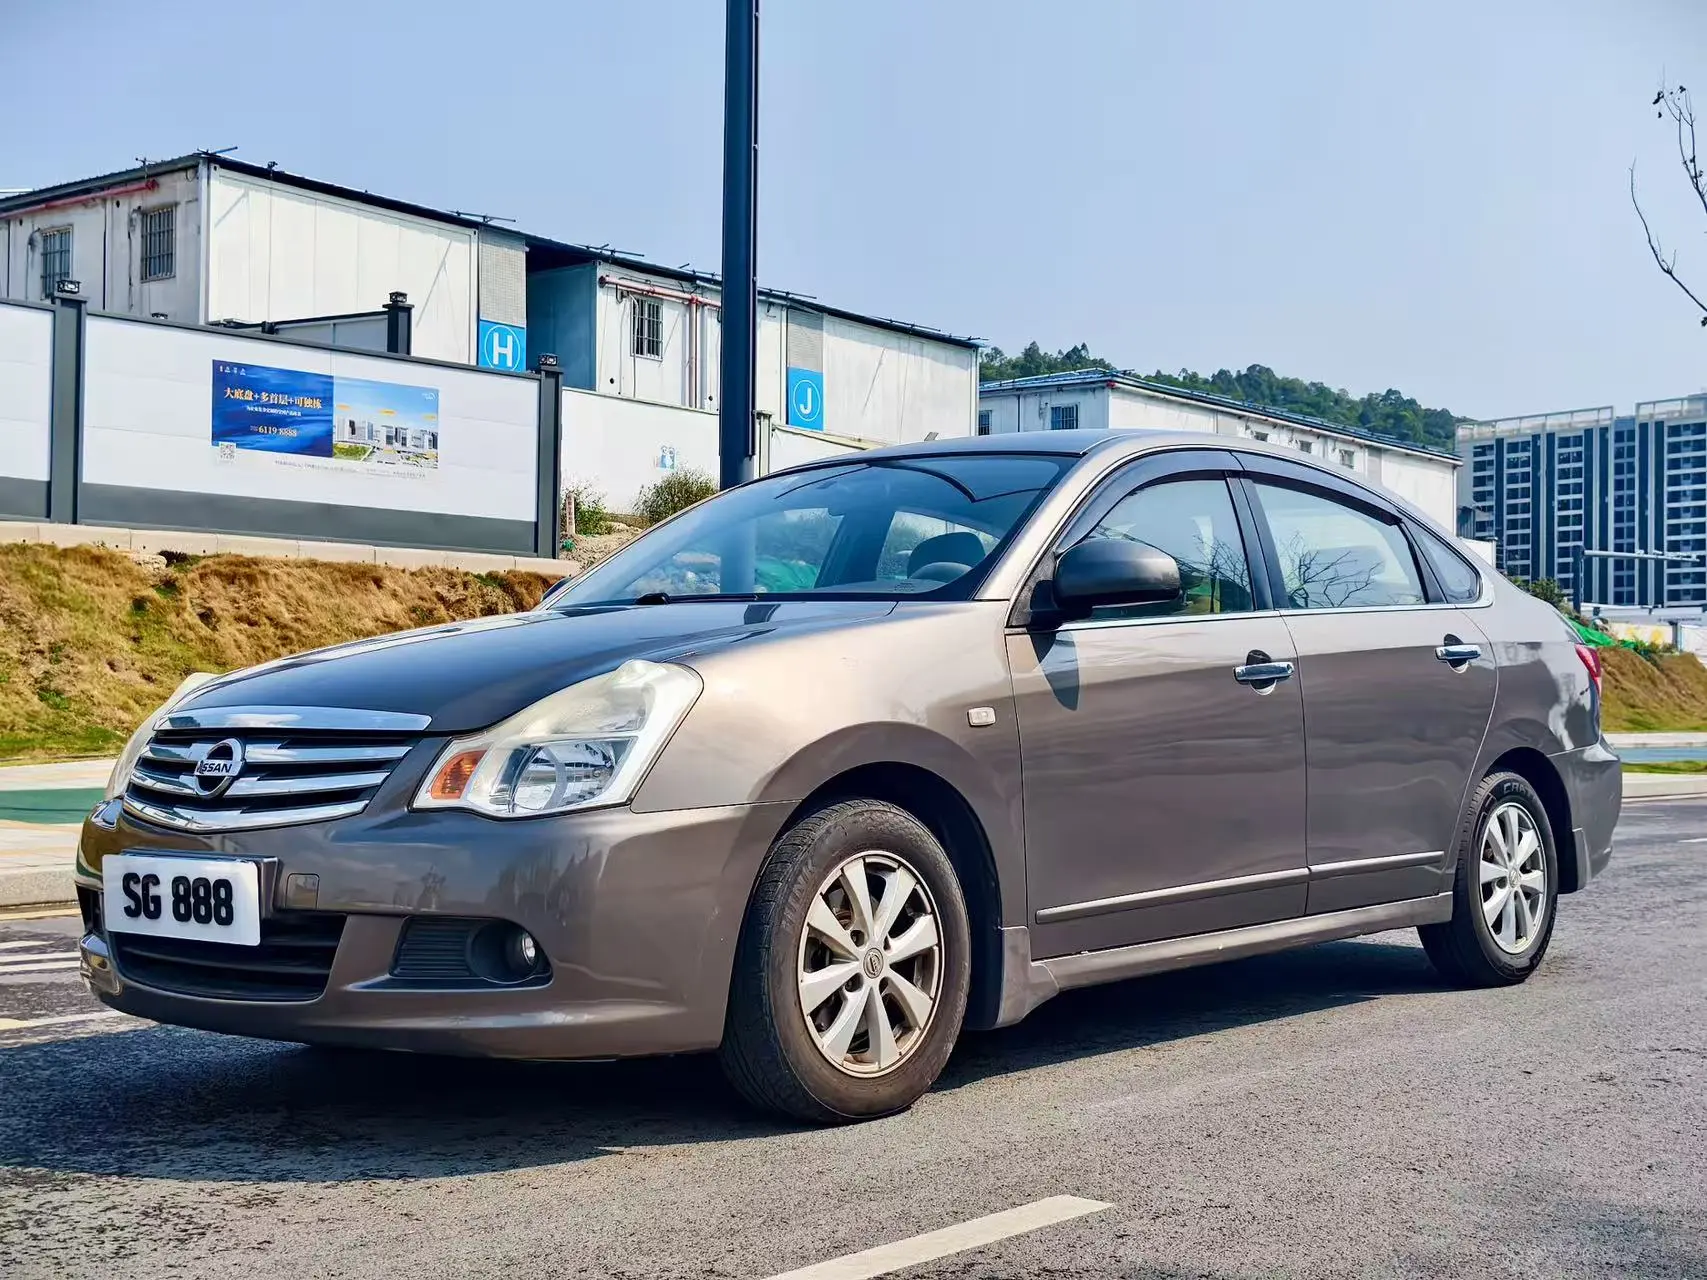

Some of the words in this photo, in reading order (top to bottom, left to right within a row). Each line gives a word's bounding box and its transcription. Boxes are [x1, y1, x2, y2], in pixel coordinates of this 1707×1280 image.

[493, 333, 513, 367] H
[799, 387, 813, 415] J
[258, 425, 277, 434] 6119
[122, 872, 162, 920] SG
[171, 876, 234, 926] 888
